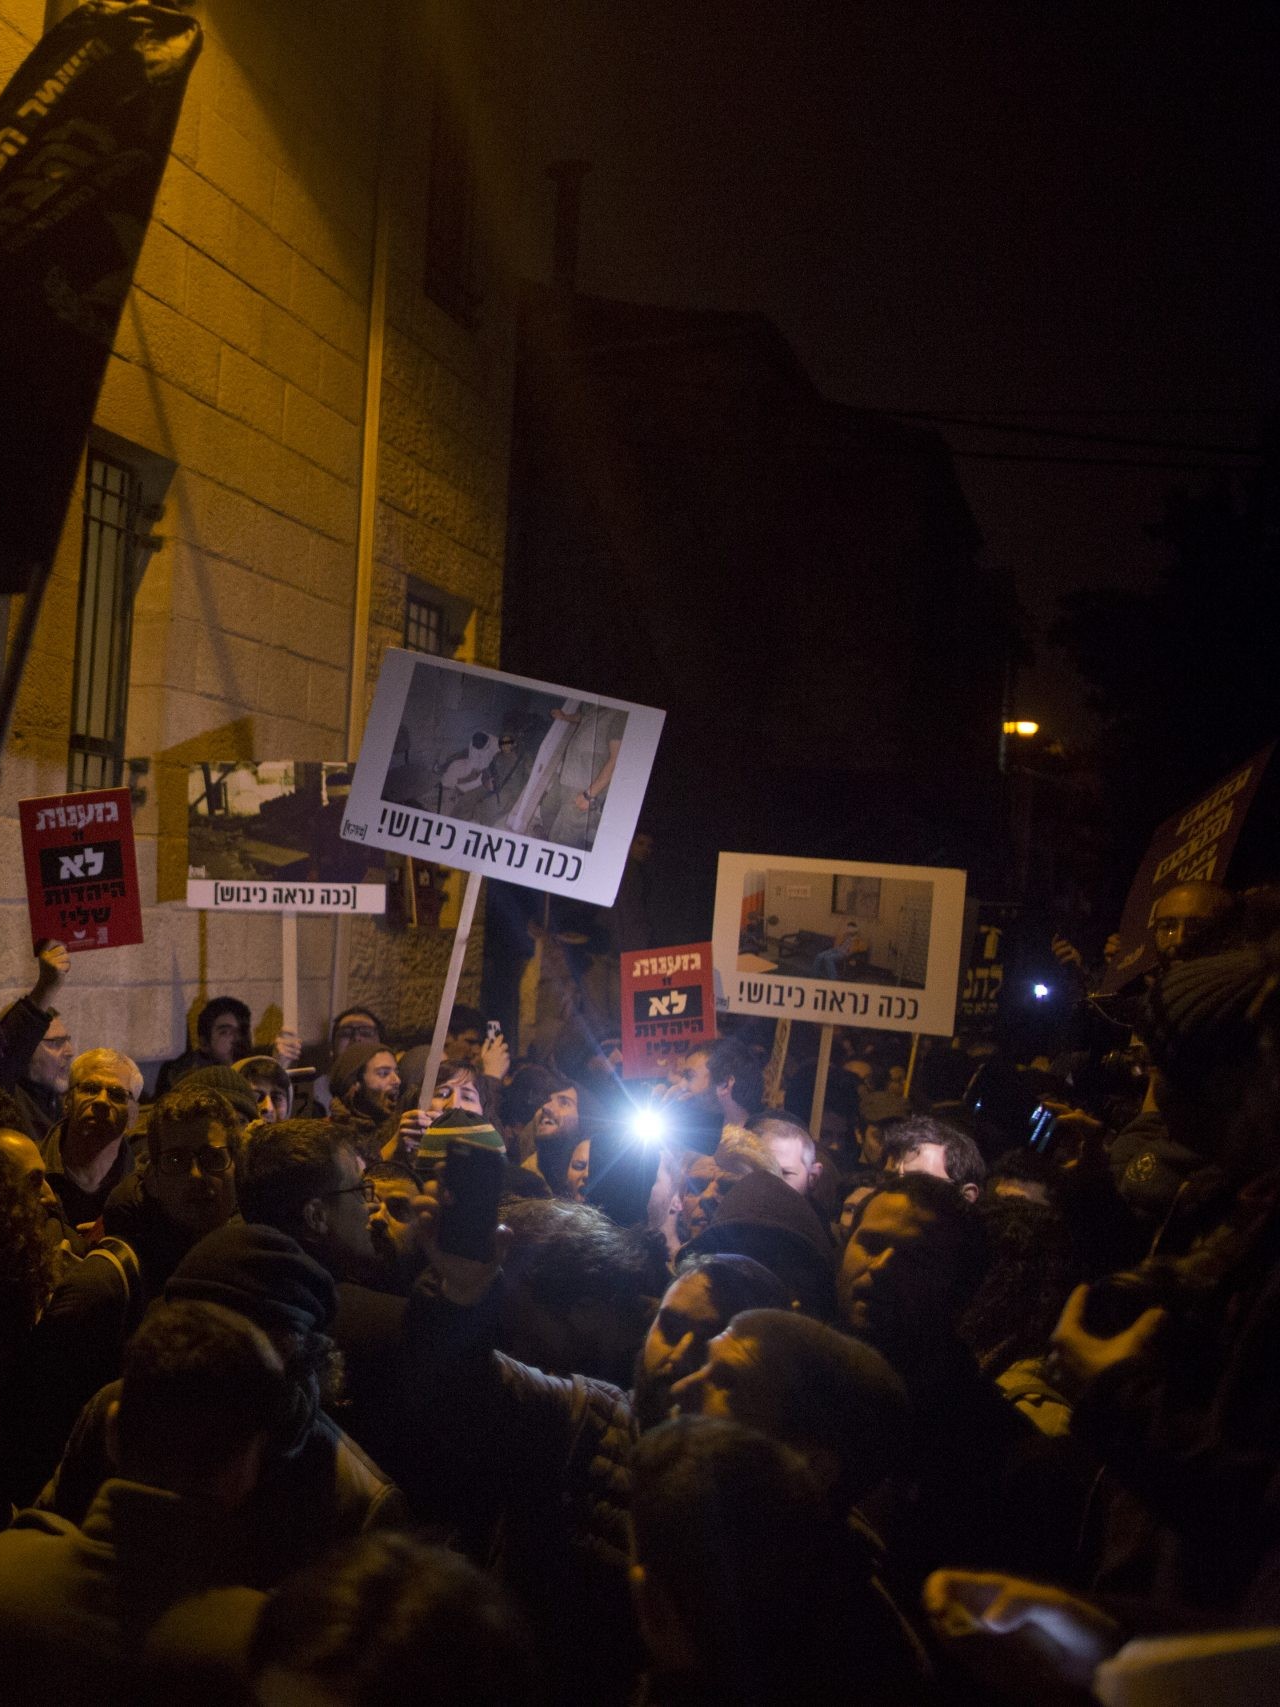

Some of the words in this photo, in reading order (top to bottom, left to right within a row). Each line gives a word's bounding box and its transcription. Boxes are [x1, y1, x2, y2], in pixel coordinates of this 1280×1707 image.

[35, 801, 119, 831] גזענות
[376, 808, 457, 849] כיבוש!
[463, 829, 529, 868] נראה
[58, 847, 105, 880] לא
[535, 848, 582, 882] ככה
[44, 880, 126, 906] היהדות
[273, 886, 316, 905] נראה
[632, 952, 701, 977] גזענות
[648, 989, 688, 1017] לא
[738, 981, 806, 1010] כיבוש!
[814, 988, 870, 1019] נראה
[878, 993, 919, 1021] ככה
[635, 1019, 704, 1038] היהדות
